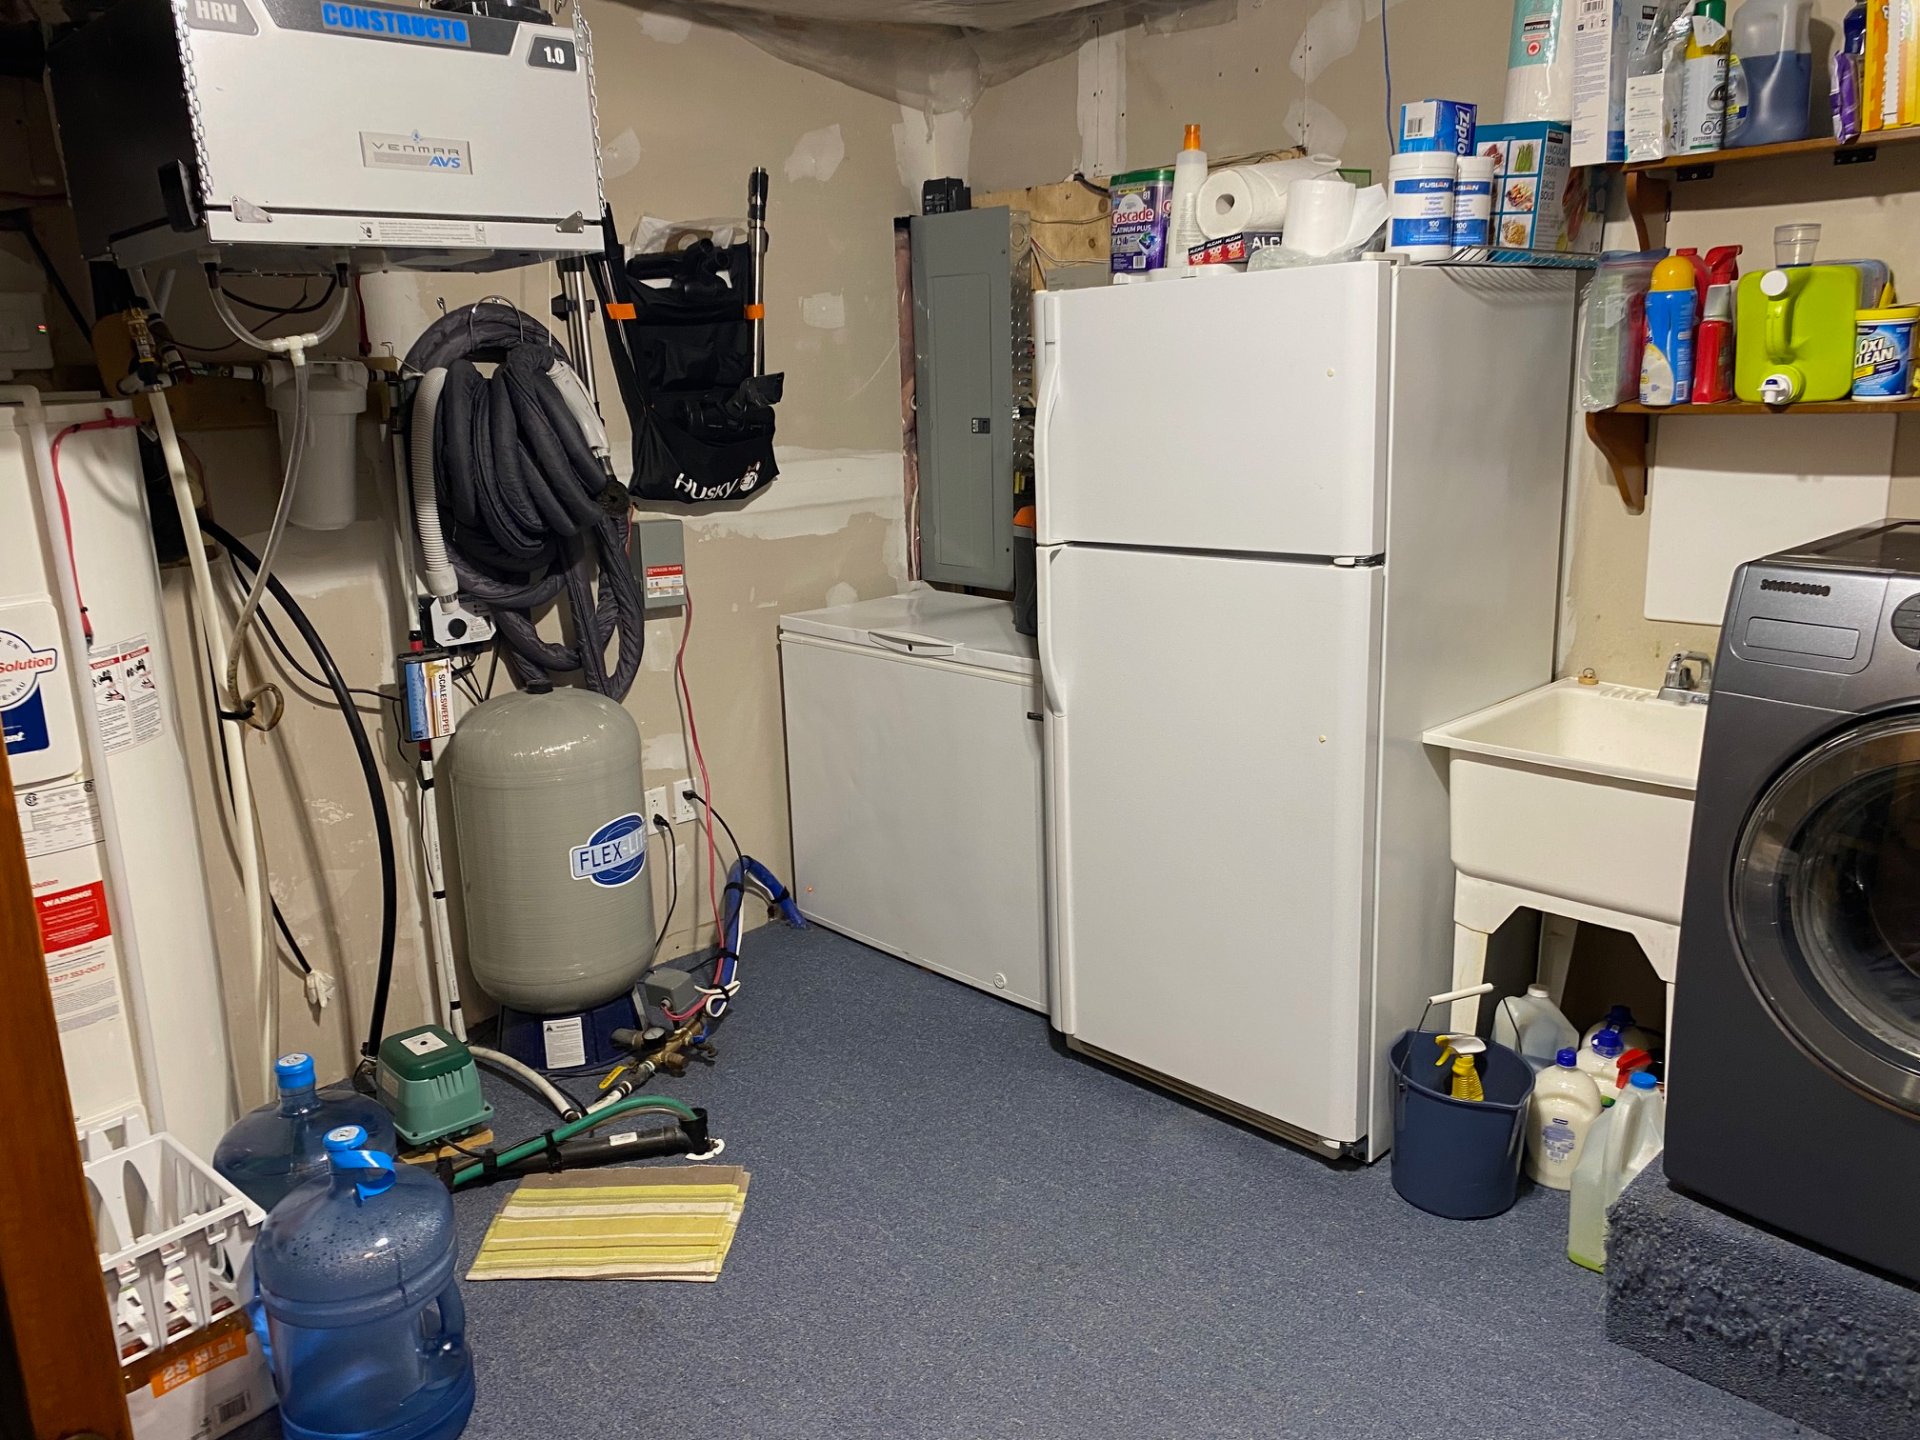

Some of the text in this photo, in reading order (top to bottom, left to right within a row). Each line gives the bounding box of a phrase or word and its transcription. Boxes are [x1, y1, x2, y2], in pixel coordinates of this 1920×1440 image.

[196, 0, 237, 24] HRV
[323, 3, 467, 43] CONSTRUCTO
[544, 46, 565, 64] 1.0
[1456, 110, 1470, 156] Ziplo
[372, 141, 460, 156] VENMAR
[429, 155, 461, 168] AVS
[1112, 206, 1154, 227] Cascade
[1136, 224, 1151, 232] PLUS
[1207, 239, 1222, 247] ALCAN
[1252, 236, 1281, 249] ALC
[1860, 337, 1885, 354] OXI
[674, 473, 738, 499] HUSKY
[1761, 578, 1831, 597] SAMSUNG
[438, 674, 449, 734] SCALESWEEPER
[580, 824, 647, 871] FLEX-LIT
[43, 889, 93, 907] WARNING!
